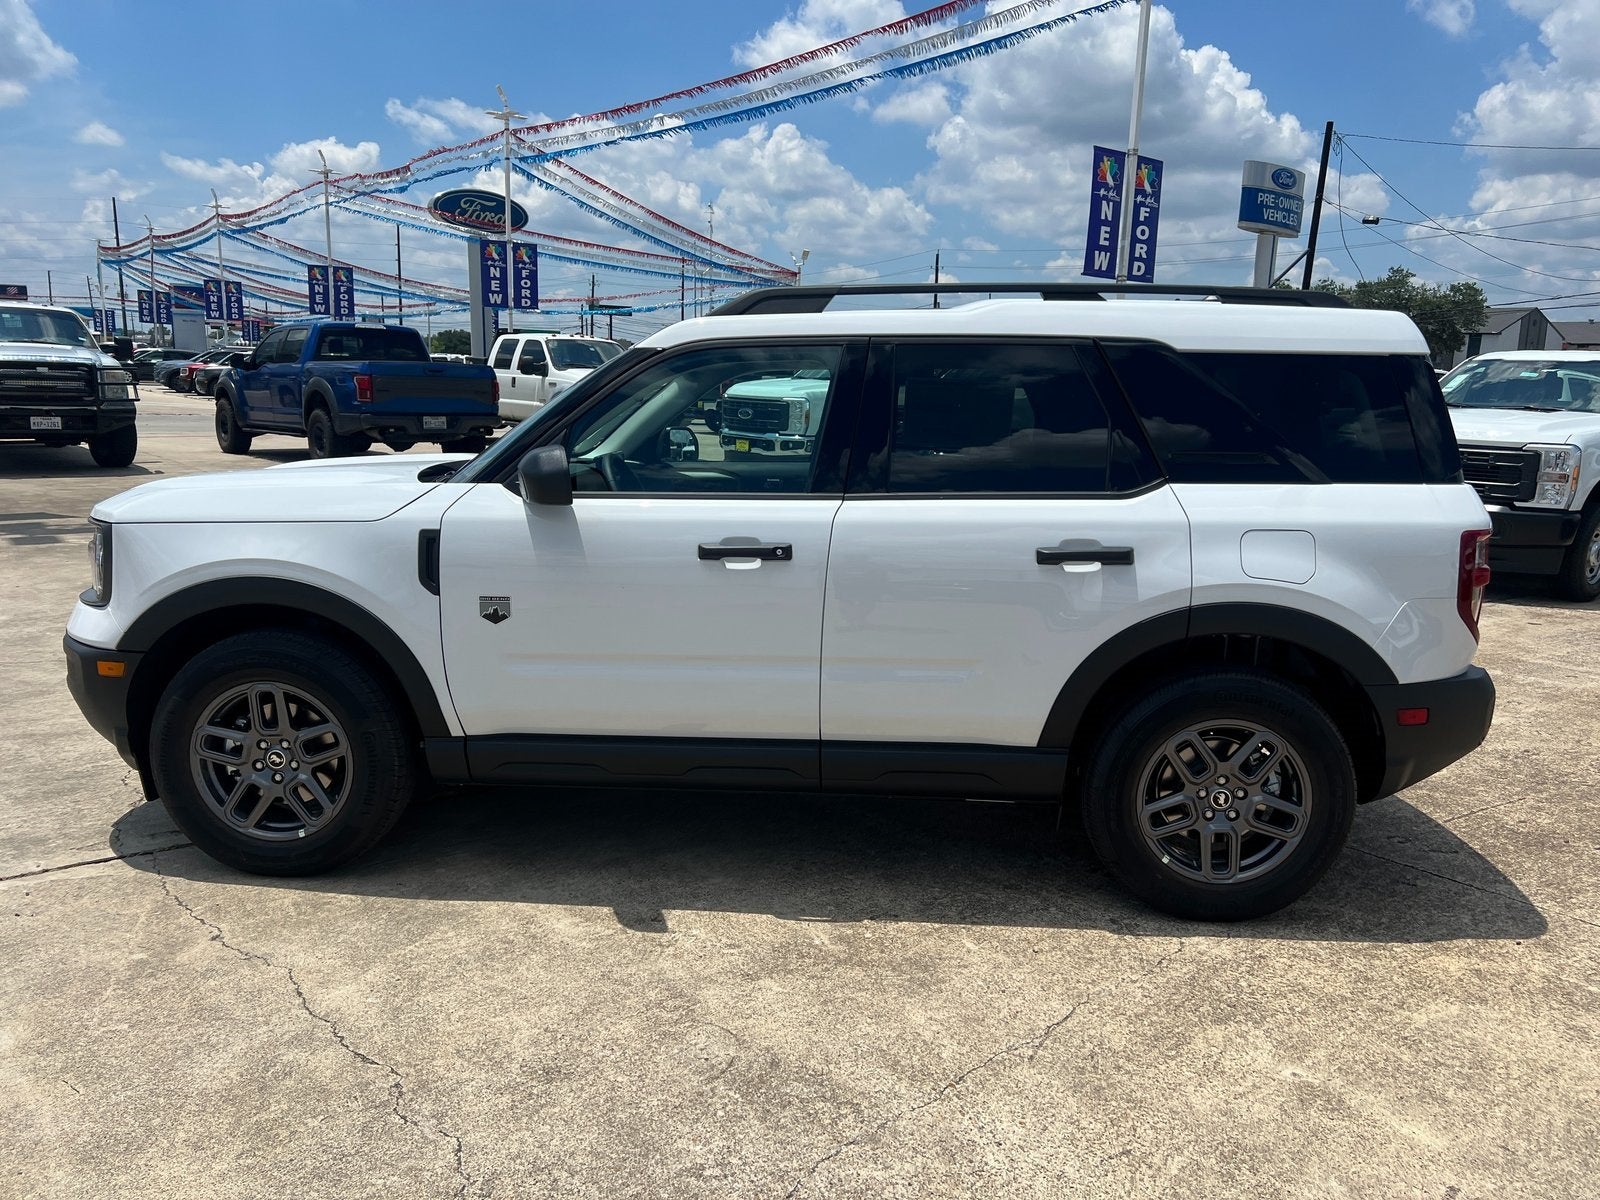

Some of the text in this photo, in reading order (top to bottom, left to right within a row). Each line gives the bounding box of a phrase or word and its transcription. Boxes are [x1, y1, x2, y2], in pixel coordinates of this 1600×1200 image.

[1279, 171, 1295, 186] Ford
[1257, 192, 1302, 213] PRE-OWNED
[1263, 207, 1298, 226] VEHICLES
[1093, 200, 1114, 272] NEW
[1132, 206, 1150, 276] FORD
[314, 284, 325, 313] NEW
[488, 267, 503, 305] NEW
[520, 269, 531, 307] FORD
[142, 303, 150, 322] NEW
[210, 295, 220, 318] NEW
[230, 296, 239, 319] FORD
[339, 286, 349, 315] FORD
